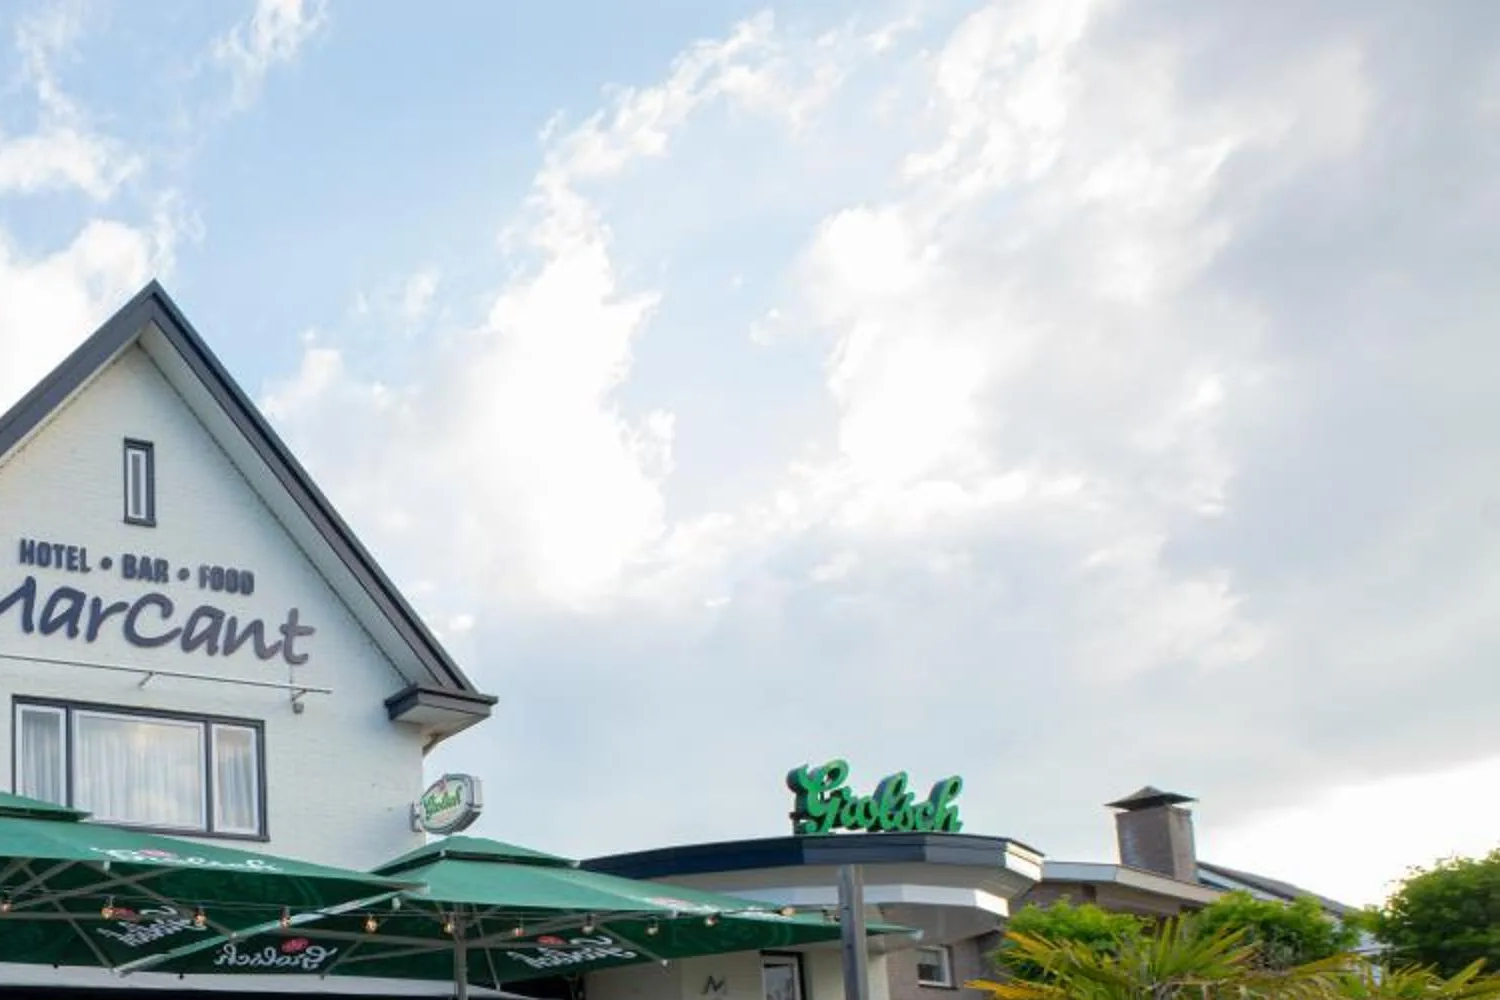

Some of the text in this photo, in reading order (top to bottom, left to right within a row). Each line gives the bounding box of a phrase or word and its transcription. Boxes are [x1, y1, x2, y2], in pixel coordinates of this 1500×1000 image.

[19, 537, 256, 596] HOTEL BAR FOOD
[788, 759, 964, 834] Grolsch
